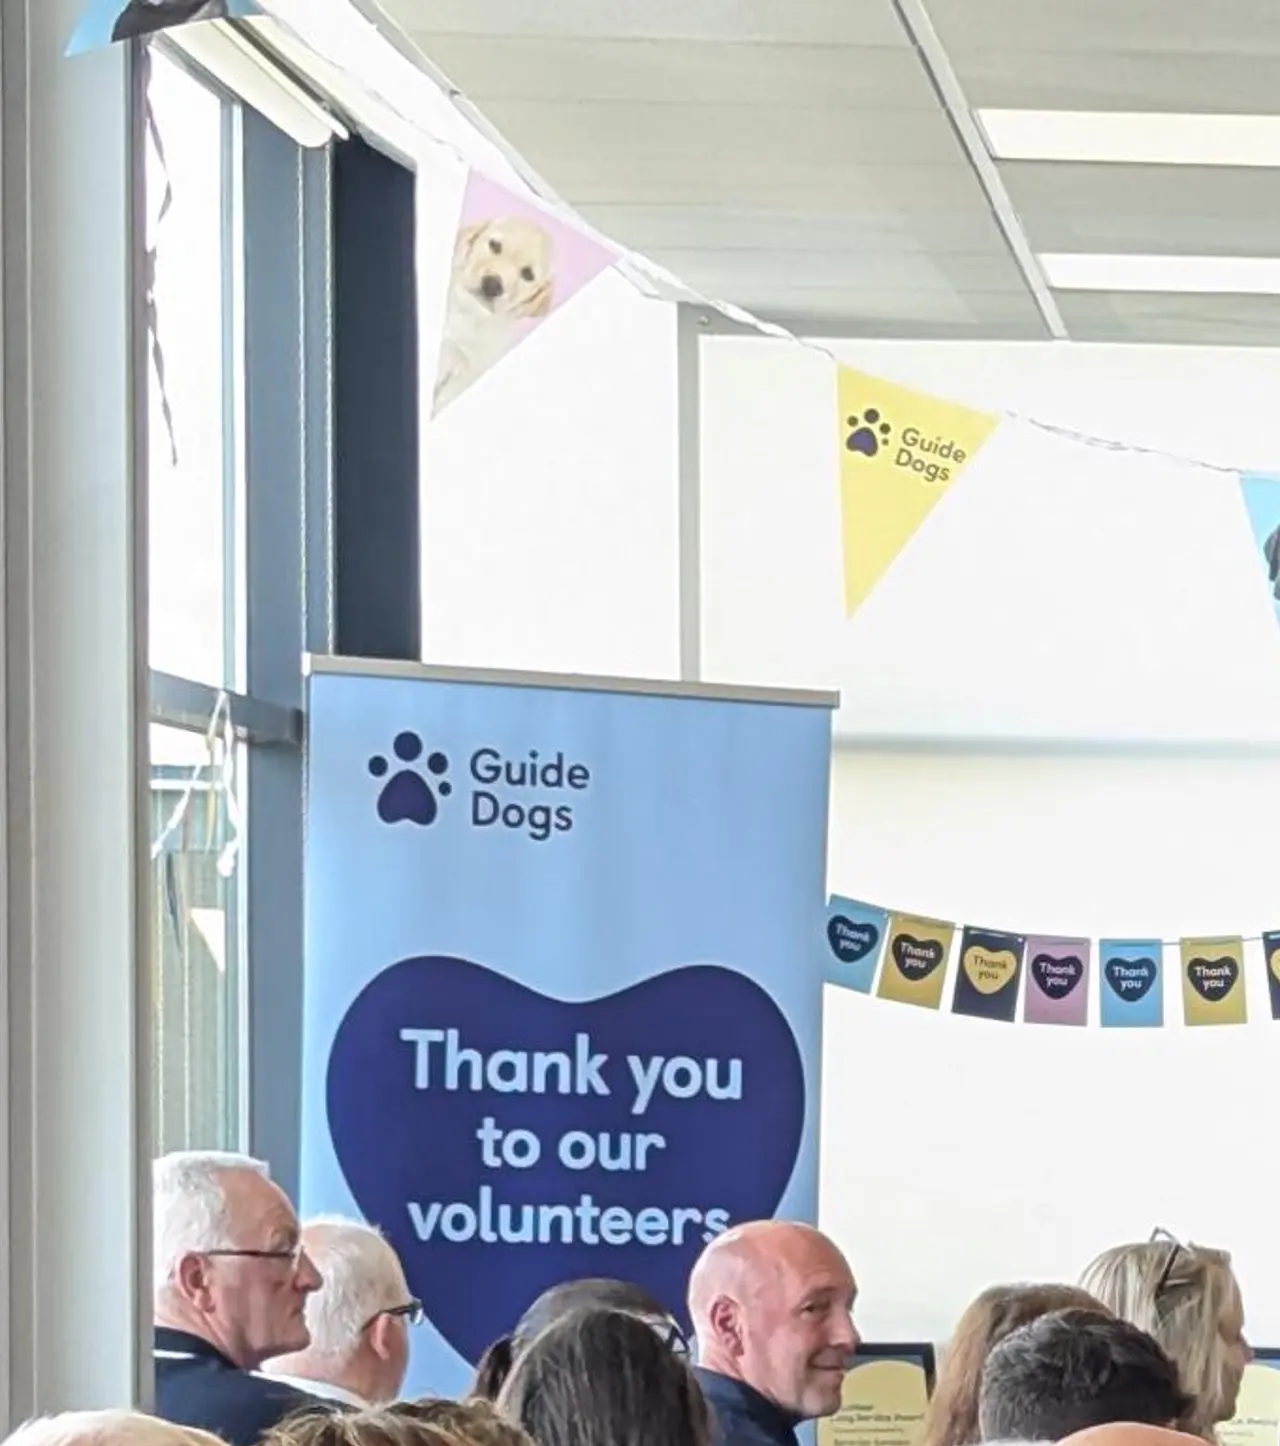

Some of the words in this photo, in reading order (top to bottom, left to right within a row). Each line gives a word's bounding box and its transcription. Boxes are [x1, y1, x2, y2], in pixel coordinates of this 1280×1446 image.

[901, 427, 967, 464] Guide
[894, 447, 950, 482] Dogs
[470, 748, 590, 790] Guide
[472, 790, 573, 841] Dogs
[835, 922, 870, 942] Thank
[839, 939, 861, 952] you
[901, 942, 936, 959] Thank
[904, 958, 927, 969] you
[973, 955, 1008, 969] Thank
[1039, 962, 1076, 975] Thank
[978, 971, 999, 980] you
[1113, 966, 1149, 977] Thank
[1194, 965, 1231, 976] Thank
[1046, 976, 1068, 988] you
[1120, 980, 1142, 992] you
[1202, 980, 1224, 991] you
[400, 1028, 610, 1095] Thank
[627, 1054, 743, 1115] you
[476, 1116, 541, 1169] to
[557, 1129, 666, 1171] our
[407, 1186, 730, 1244] volunteers
